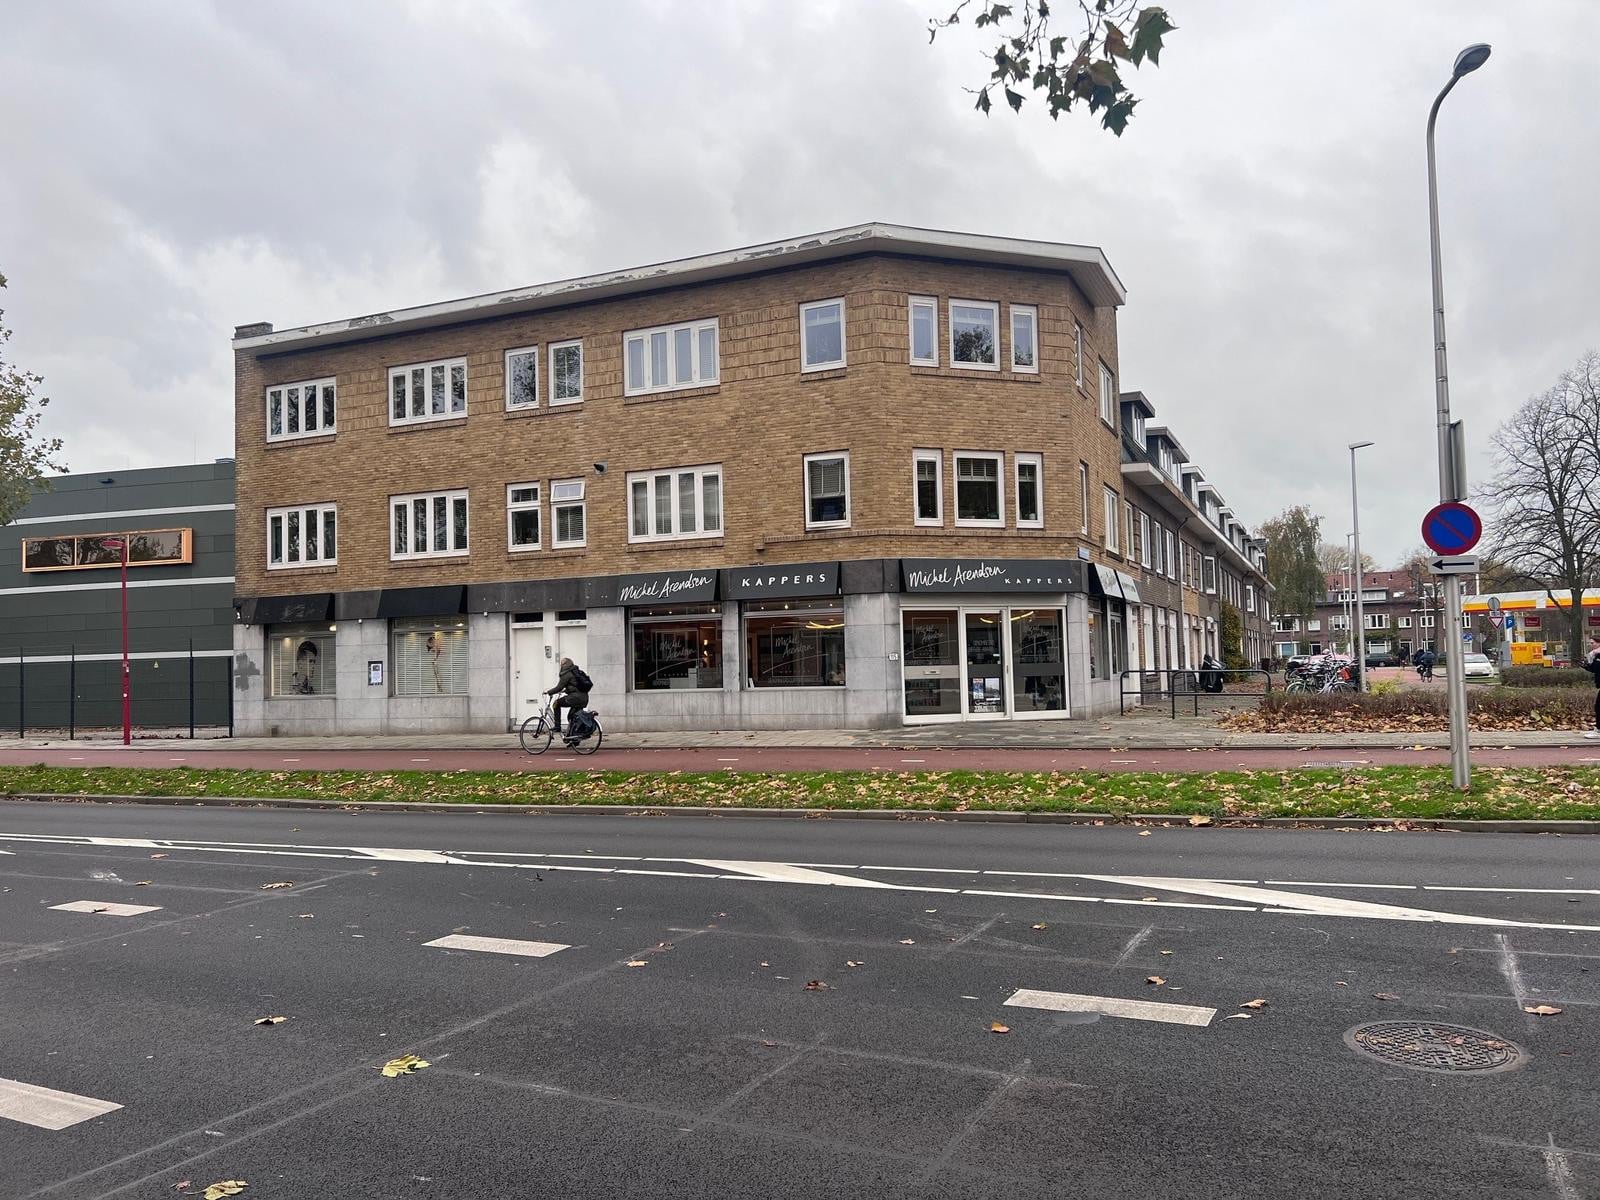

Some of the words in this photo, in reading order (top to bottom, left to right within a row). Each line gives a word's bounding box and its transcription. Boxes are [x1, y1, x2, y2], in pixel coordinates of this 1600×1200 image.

[620, 583, 659, 601] Michel
[658, 573, 713, 598] Arendsen
[741, 573, 826, 587] KAPPERS
[910, 567, 952, 587] Michel
[953, 562, 1006, 586] Arendsen
